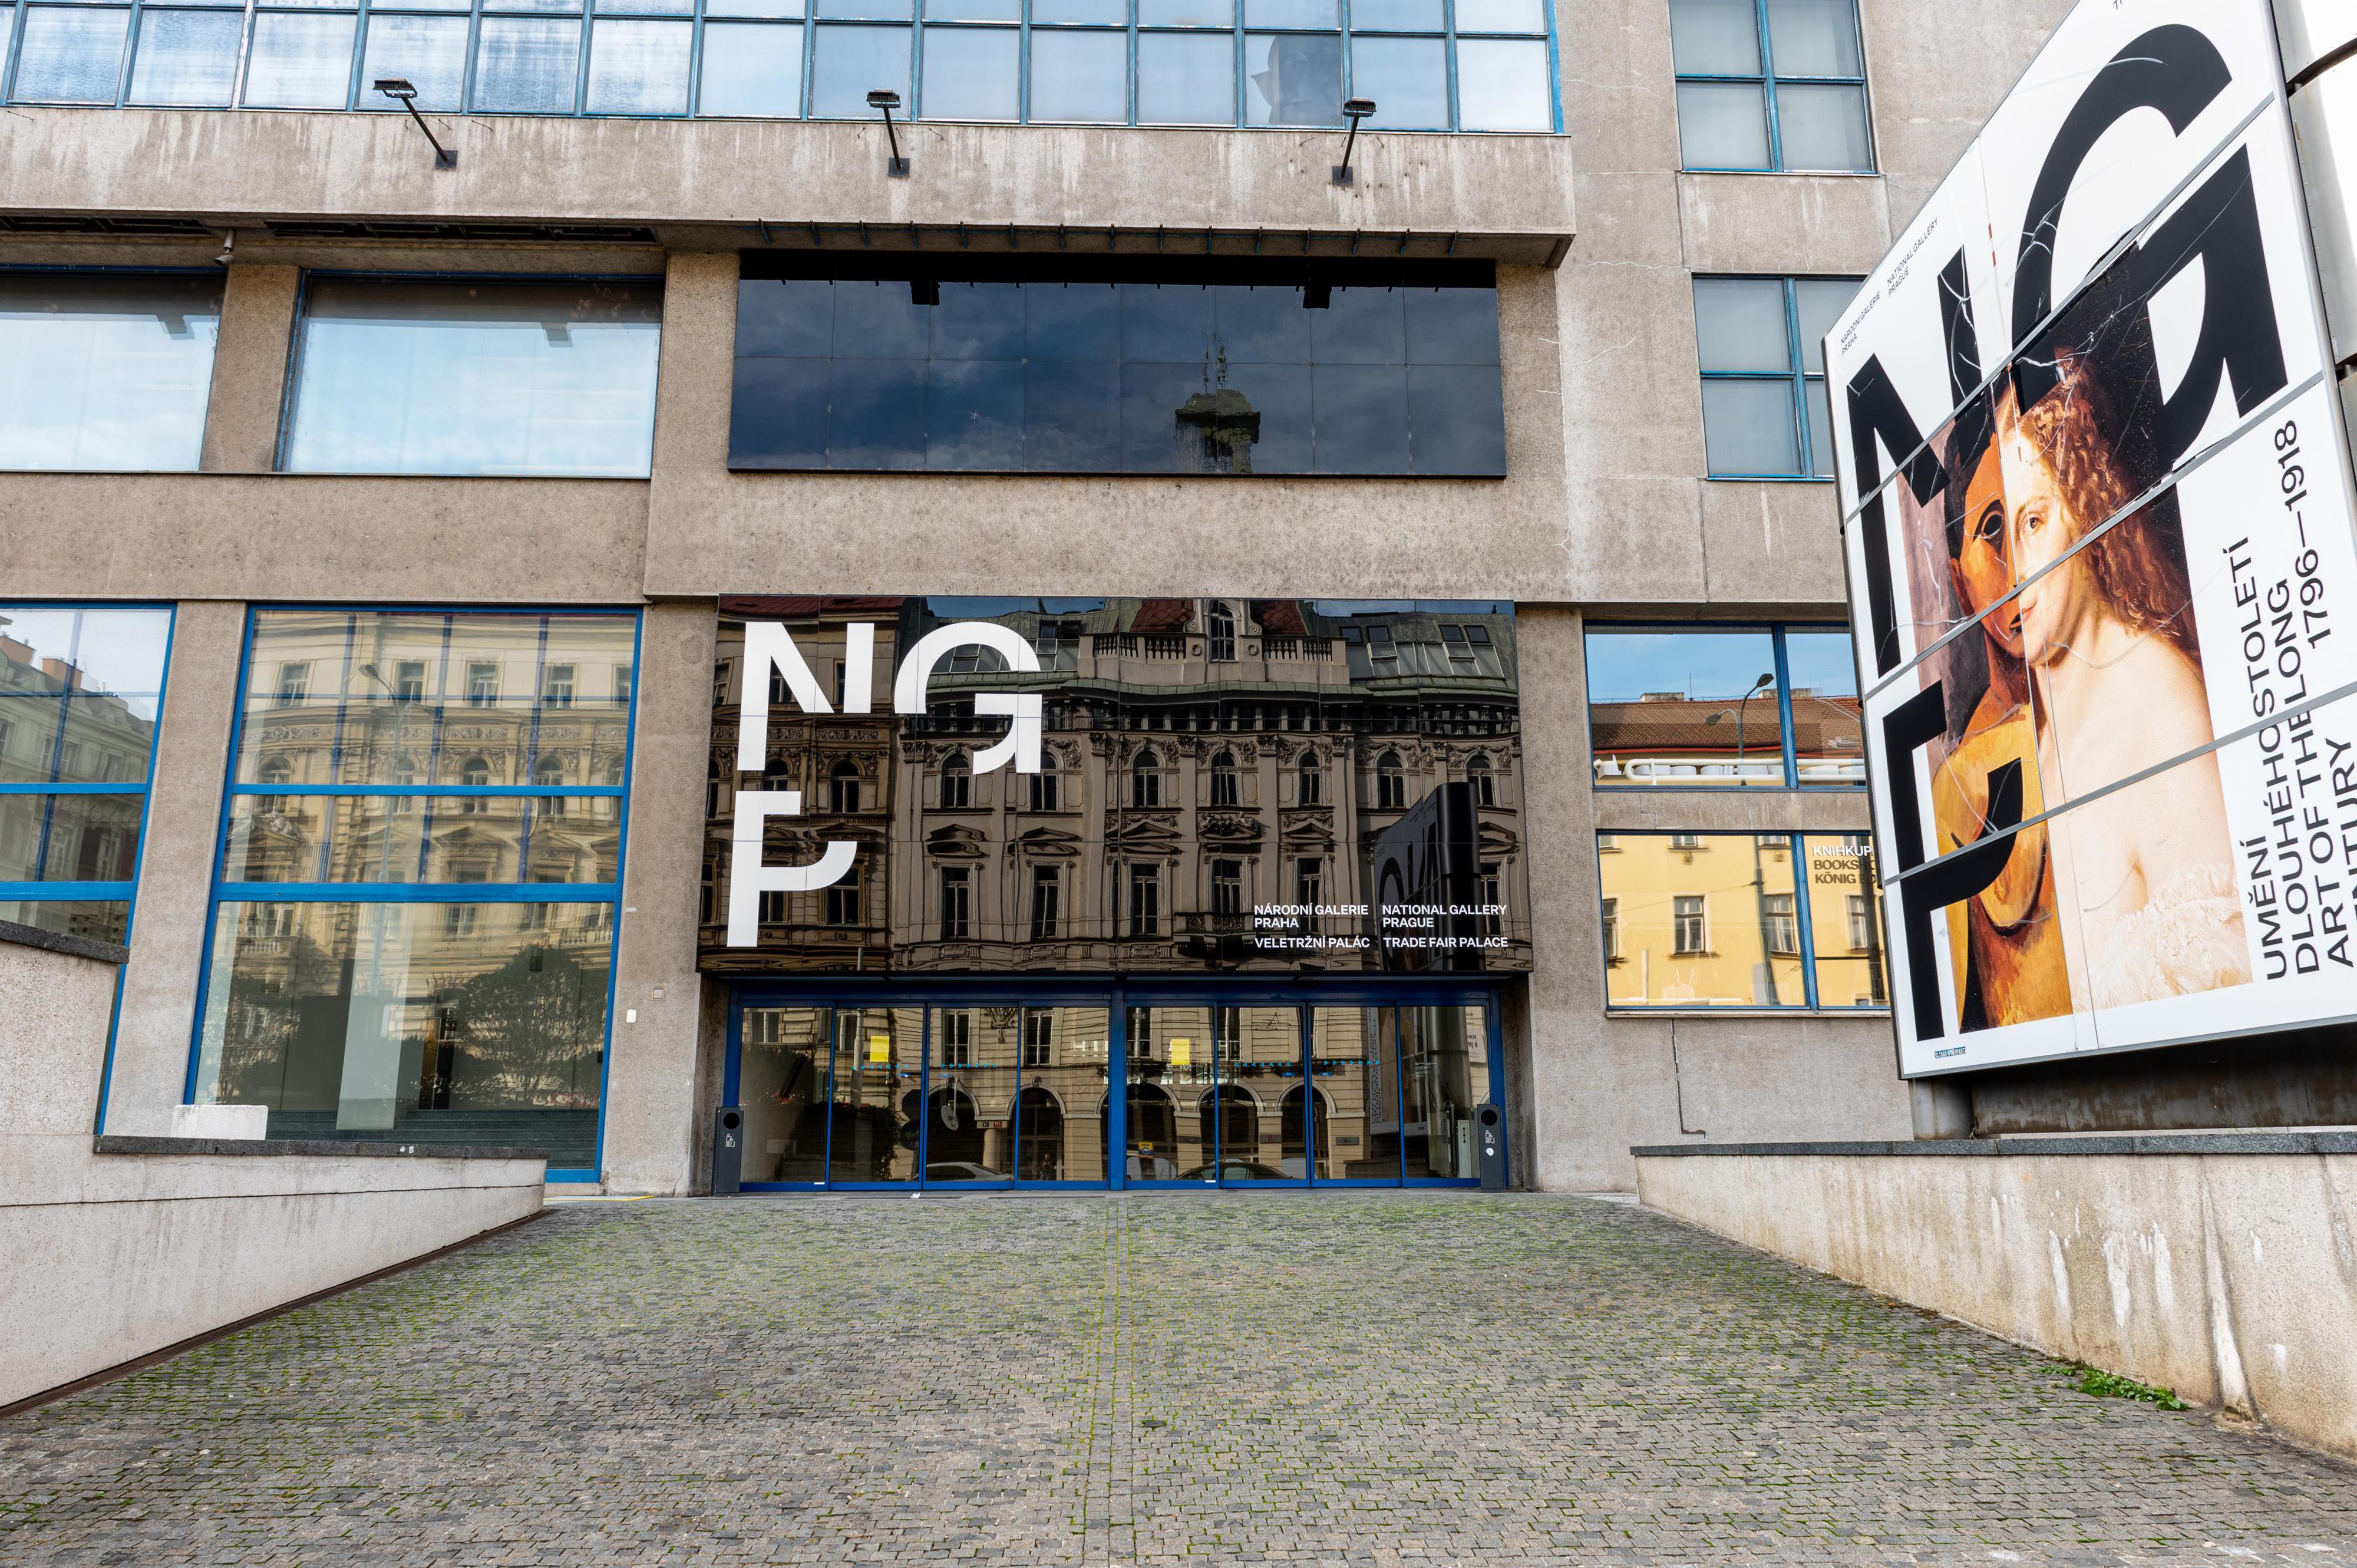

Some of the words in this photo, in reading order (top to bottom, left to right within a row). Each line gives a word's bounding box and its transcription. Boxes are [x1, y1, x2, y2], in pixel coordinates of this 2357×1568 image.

[1887, 251, 1913, 286] NATIONAL
[1913, 216, 1938, 253] GALLERY
[1888, 266, 1910, 297] PRAGUE
[1860, 291, 1881, 321] GALERIE
[1841, 333, 1857, 356] PRAHA
[2222, 536, 2275, 718] STOLETÍ
[2267, 578, 2307, 705] LONG
[2287, 710, 2322, 799] THE
[2259, 724, 2320, 975] DLOUHÉHO
[2303, 806, 2333, 864] OF
[1813, 845, 1874, 856] KNIHKUP
[1814, 859, 1876, 870] BOOKSHO
[1254, 902, 1313, 915] NÁRODNÍ
[1315, 905, 1369, 915] GALERIE
[1255, 917, 1299, 928] PRAHA
[1382, 905, 1447, 915] NATIONAL
[1449, 905, 1507, 915] GALLERY
[1382, 917, 1434, 927] PRAGUE
[2239, 835, 2287, 981] UMĚNÍ
[2315, 874, 2354, 968] ART
[1255, 935, 1326, 948] VELETRŽNÍ
[1329, 935, 1370, 948] PALÁC
[1383, 937, 1427, 948] TRADE
[1429, 937, 1457, 948] FAIR
[1459, 937, 1508, 948] PALACE
